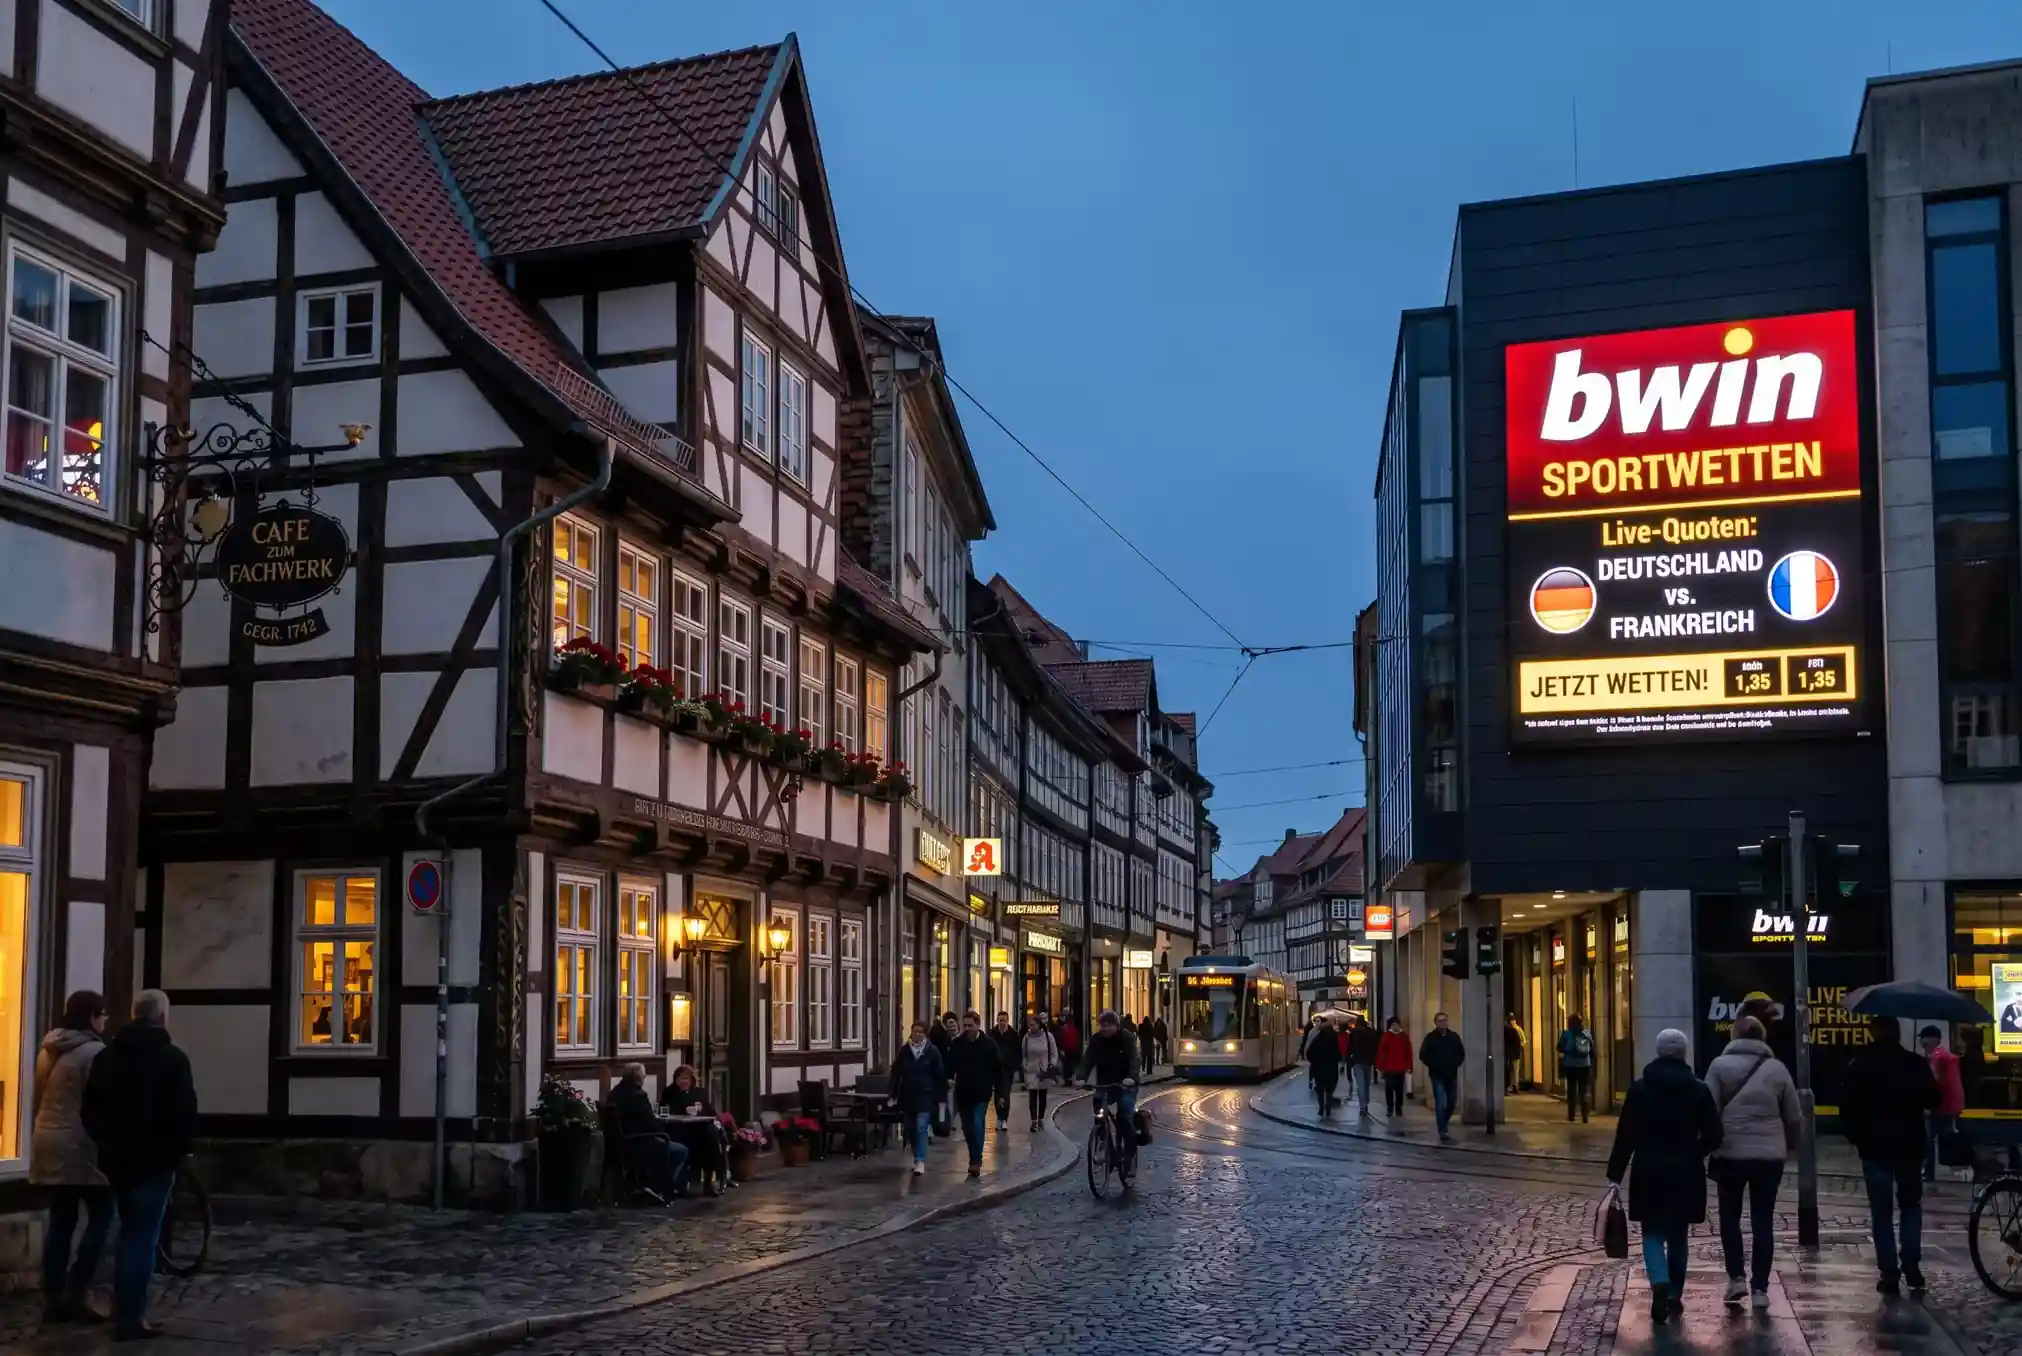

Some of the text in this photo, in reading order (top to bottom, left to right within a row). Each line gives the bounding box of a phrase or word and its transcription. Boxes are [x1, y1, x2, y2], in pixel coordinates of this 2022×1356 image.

[1540, 328, 1822, 441] bwin
[1542, 441, 1822, 497] SPORTWETTEN
[252, 519, 310, 544] CAFE
[1602, 516, 1757, 546] Live-Quoten:
[266, 546, 295, 558] ZUM
[1598, 549, 1763, 581] DEUTSCHLAND
[229, 558, 333, 584] FACHWERK
[287, 619, 317, 639] 1742
[1610, 610, 1754, 639] FRANKREICH
[1530, 669, 1709, 698] JETZT WETTEN!
[1735, 672, 1771, 694] 1,35
[1798, 671, 1835, 691] 1,35
